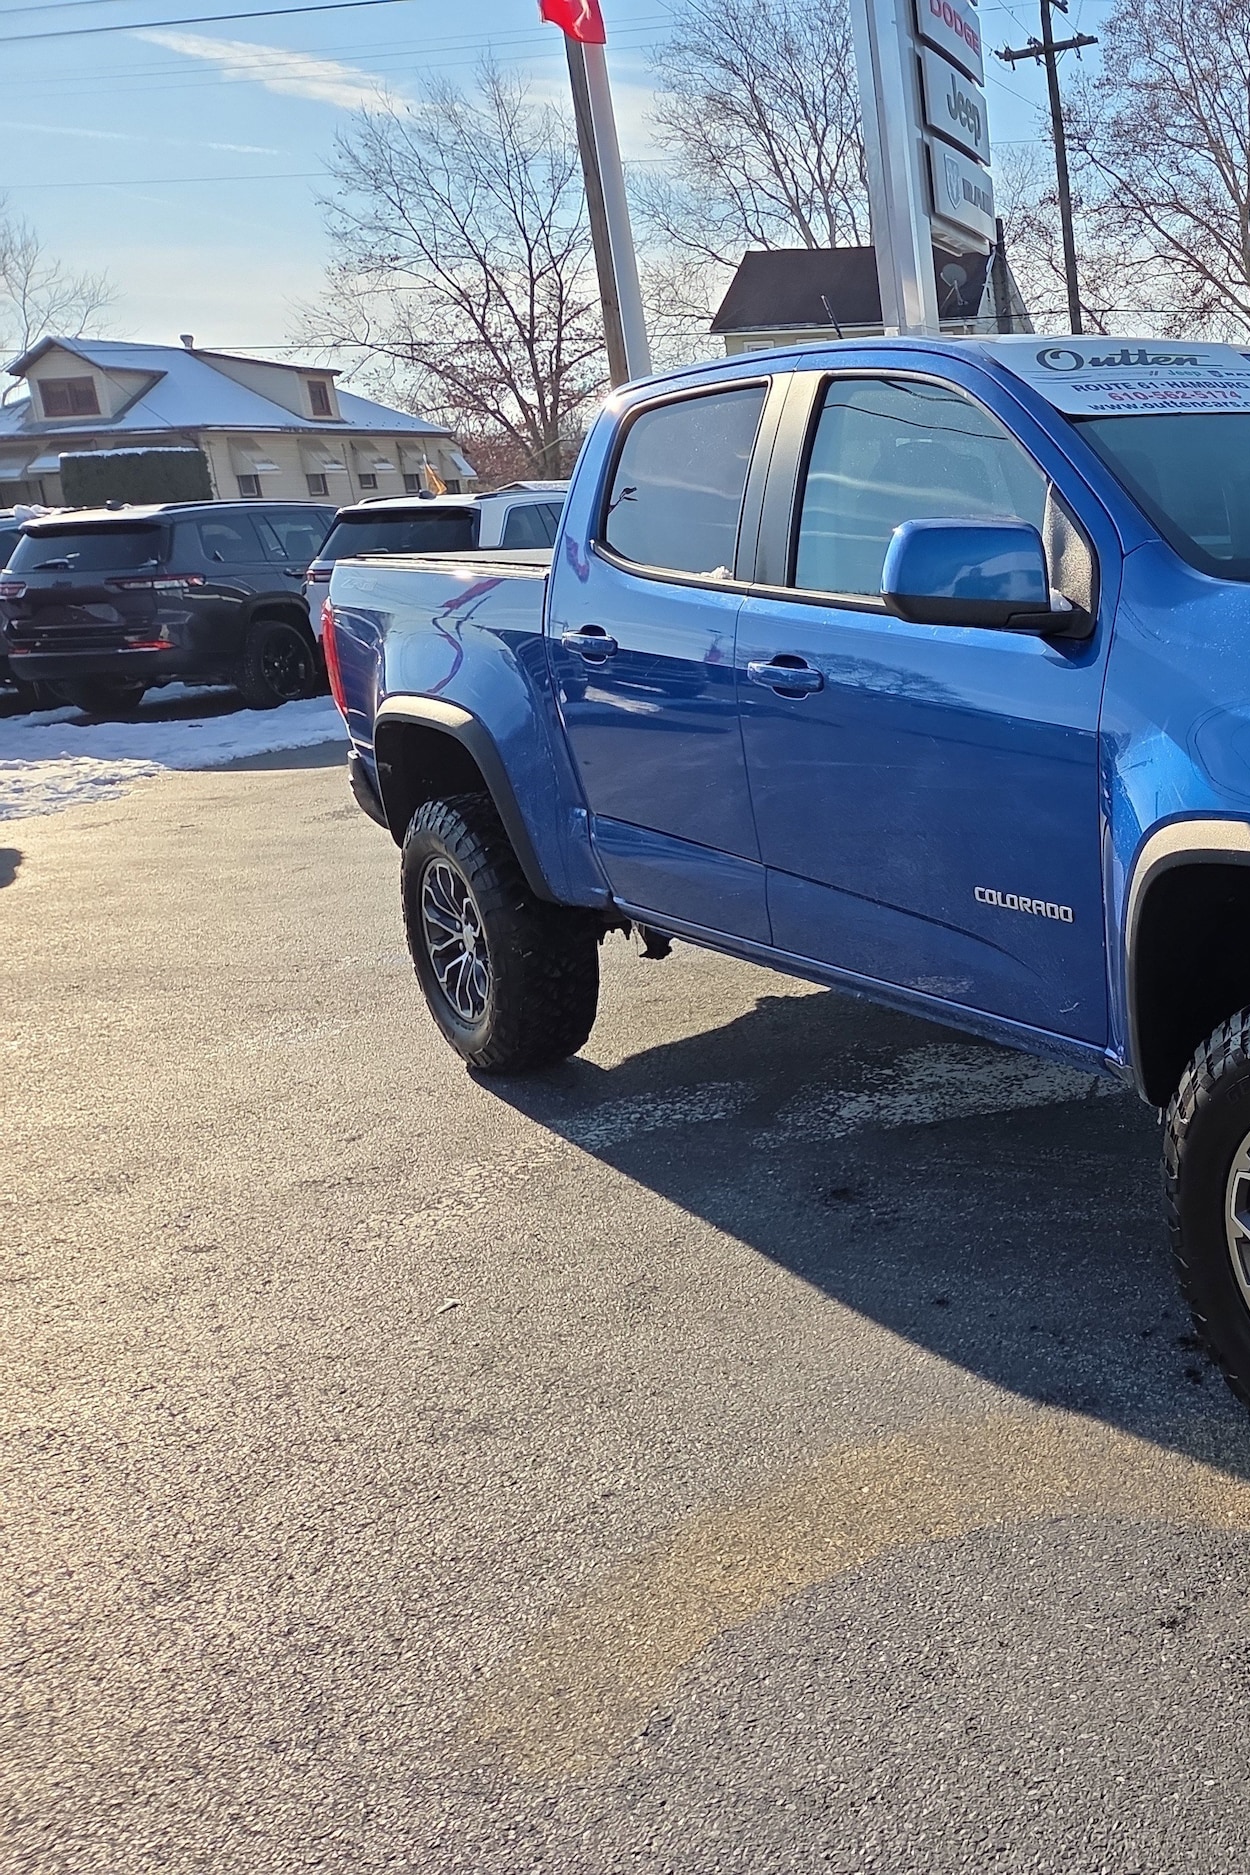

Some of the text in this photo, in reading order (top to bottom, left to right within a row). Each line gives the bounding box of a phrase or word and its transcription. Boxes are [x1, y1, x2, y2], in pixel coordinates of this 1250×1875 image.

[929, 0, 980, 57] DODGE
[946, 73, 982, 146] Jeep
[962, 177, 992, 217] RAM
[1036, 347, 1222, 371] Outten
[1167, 369, 1202, 377] Jeep
[1071, 382, 1137, 392] ROUTE
[1107, 390, 1242, 401] 610-562-5174
[974, 886, 1073, 923] COLORADO
